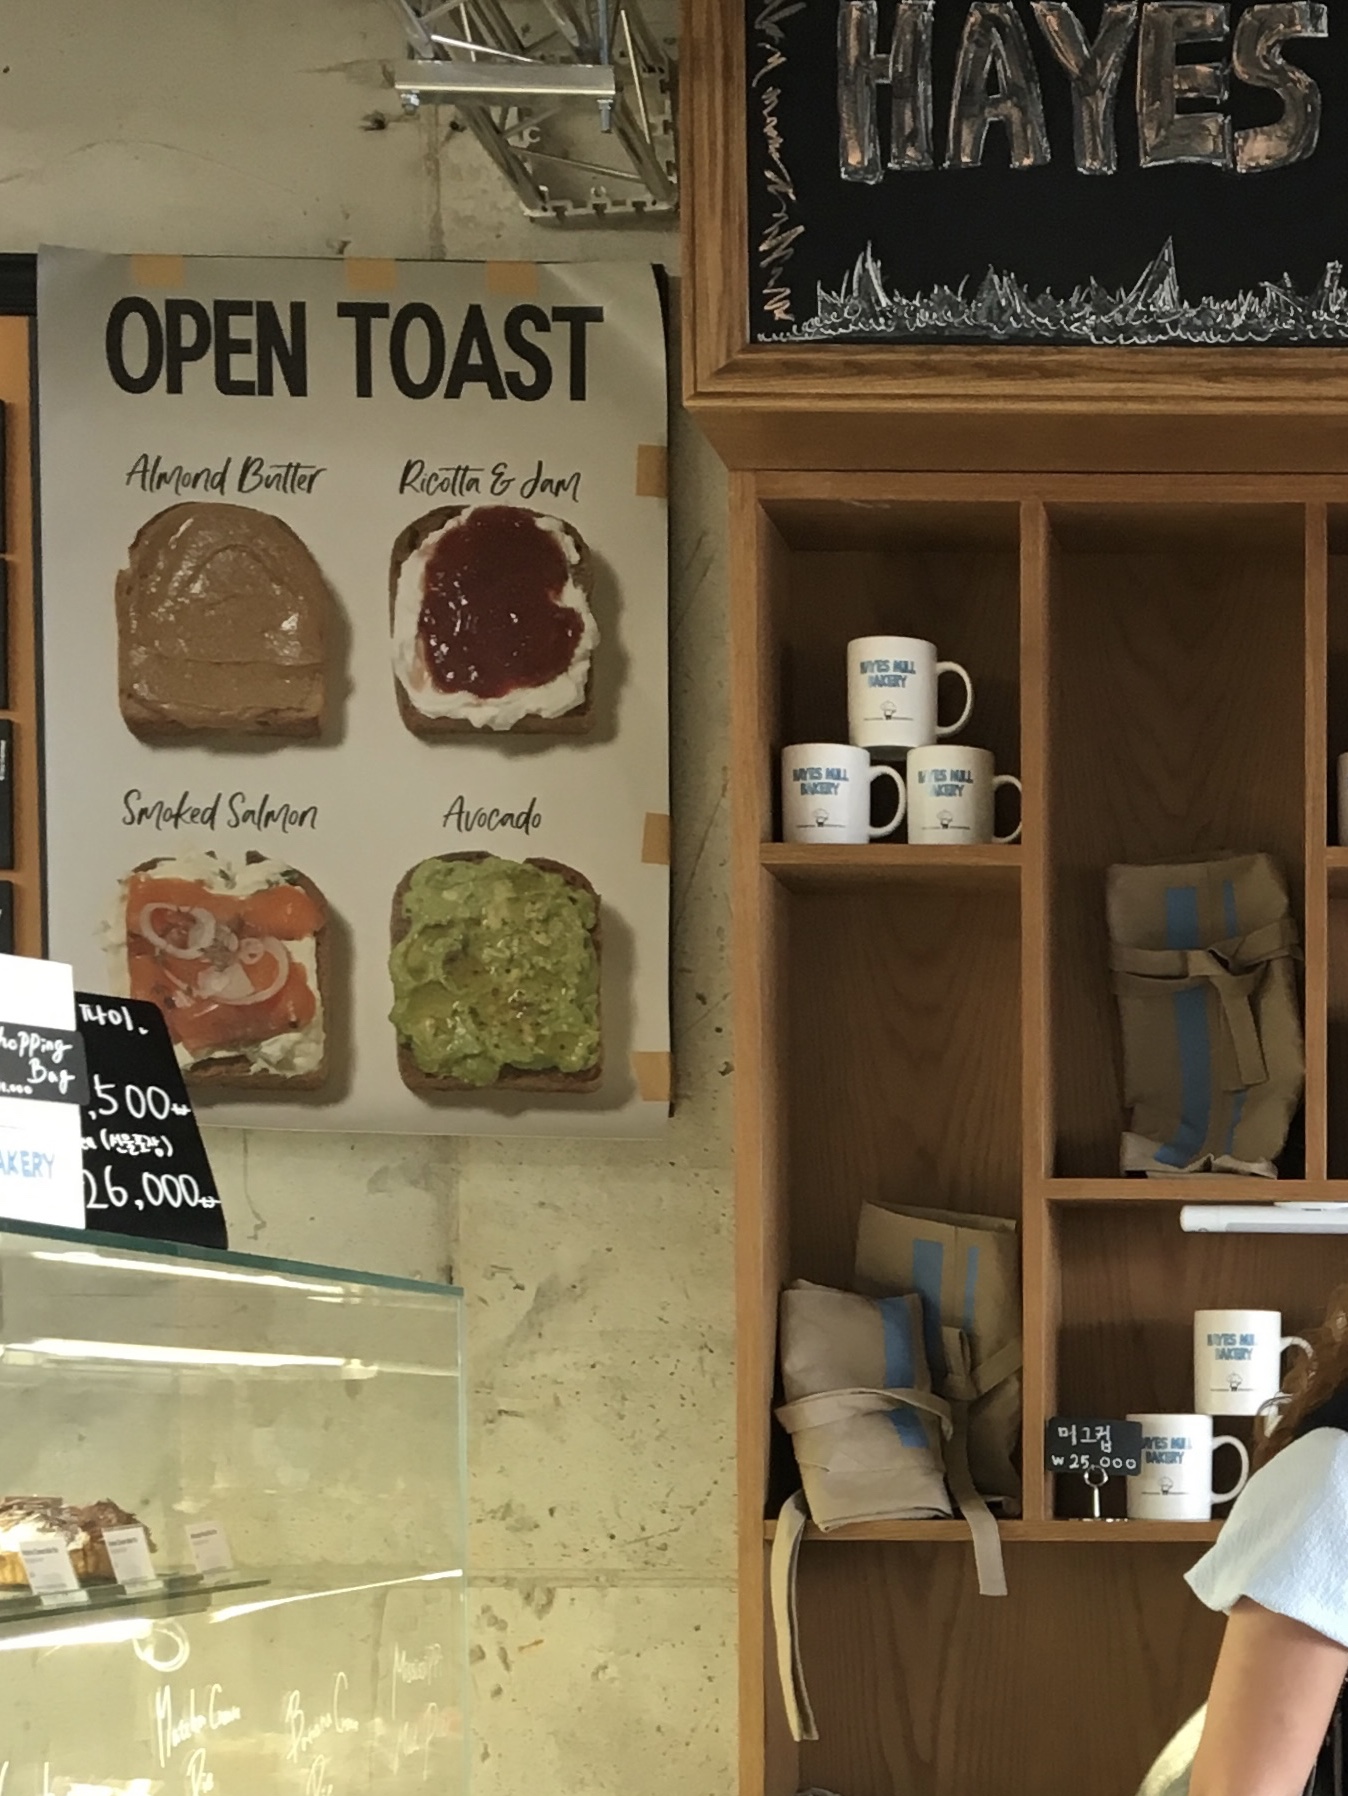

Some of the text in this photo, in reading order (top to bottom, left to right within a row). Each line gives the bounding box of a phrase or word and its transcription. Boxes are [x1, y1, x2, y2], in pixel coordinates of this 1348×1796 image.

[838, 1, 1329, 184] HAYES
[105, 296, 604, 401] OPEN TOAST
[126, 453, 328, 496] Almond Butter
[399, 459, 581, 501] Ricotta & Jam
[918, 769, 947, 784] HYES
[926, 783, 965, 797] AKERY
[122, 788, 319, 833] Smoked Salmon
[443, 795, 542, 833] Avocado
[0, 1026, 73, 1063] hopping
[27, 1057, 76, 1094] Bag
[1239, 1333, 1258, 1347] MIL
[1057, 1424, 1112, 1453] 머그컵
